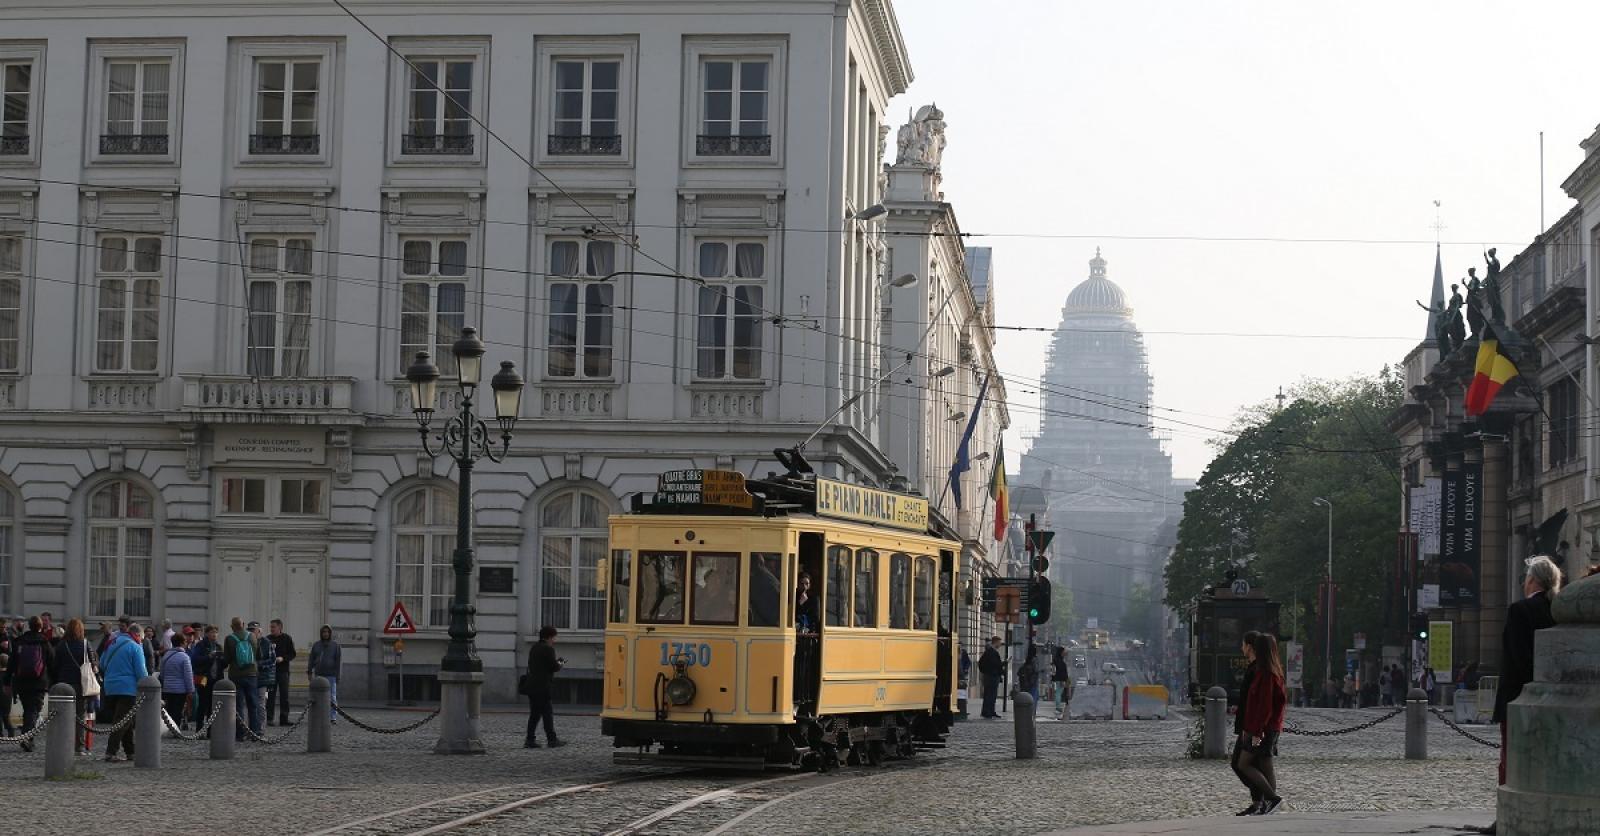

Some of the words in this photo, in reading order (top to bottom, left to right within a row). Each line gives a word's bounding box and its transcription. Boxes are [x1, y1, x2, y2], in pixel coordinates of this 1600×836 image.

[664, 471, 686, 483] QUATRE
[686, 470, 702, 481] BRAS
[676, 492, 700, 504] NAMUR
[819, 480, 830, 509] LE
[833, 483, 860, 514] PIANO
[1446, 480, 1457, 527] DELVOYE
[1464, 472, 1475, 521] DELVOYE
[1445, 531, 1455, 556] WIM
[1463, 527, 1473, 553] WIM
[1233, 581, 1247, 595] 29
[660, 642, 711, 667] 1750
